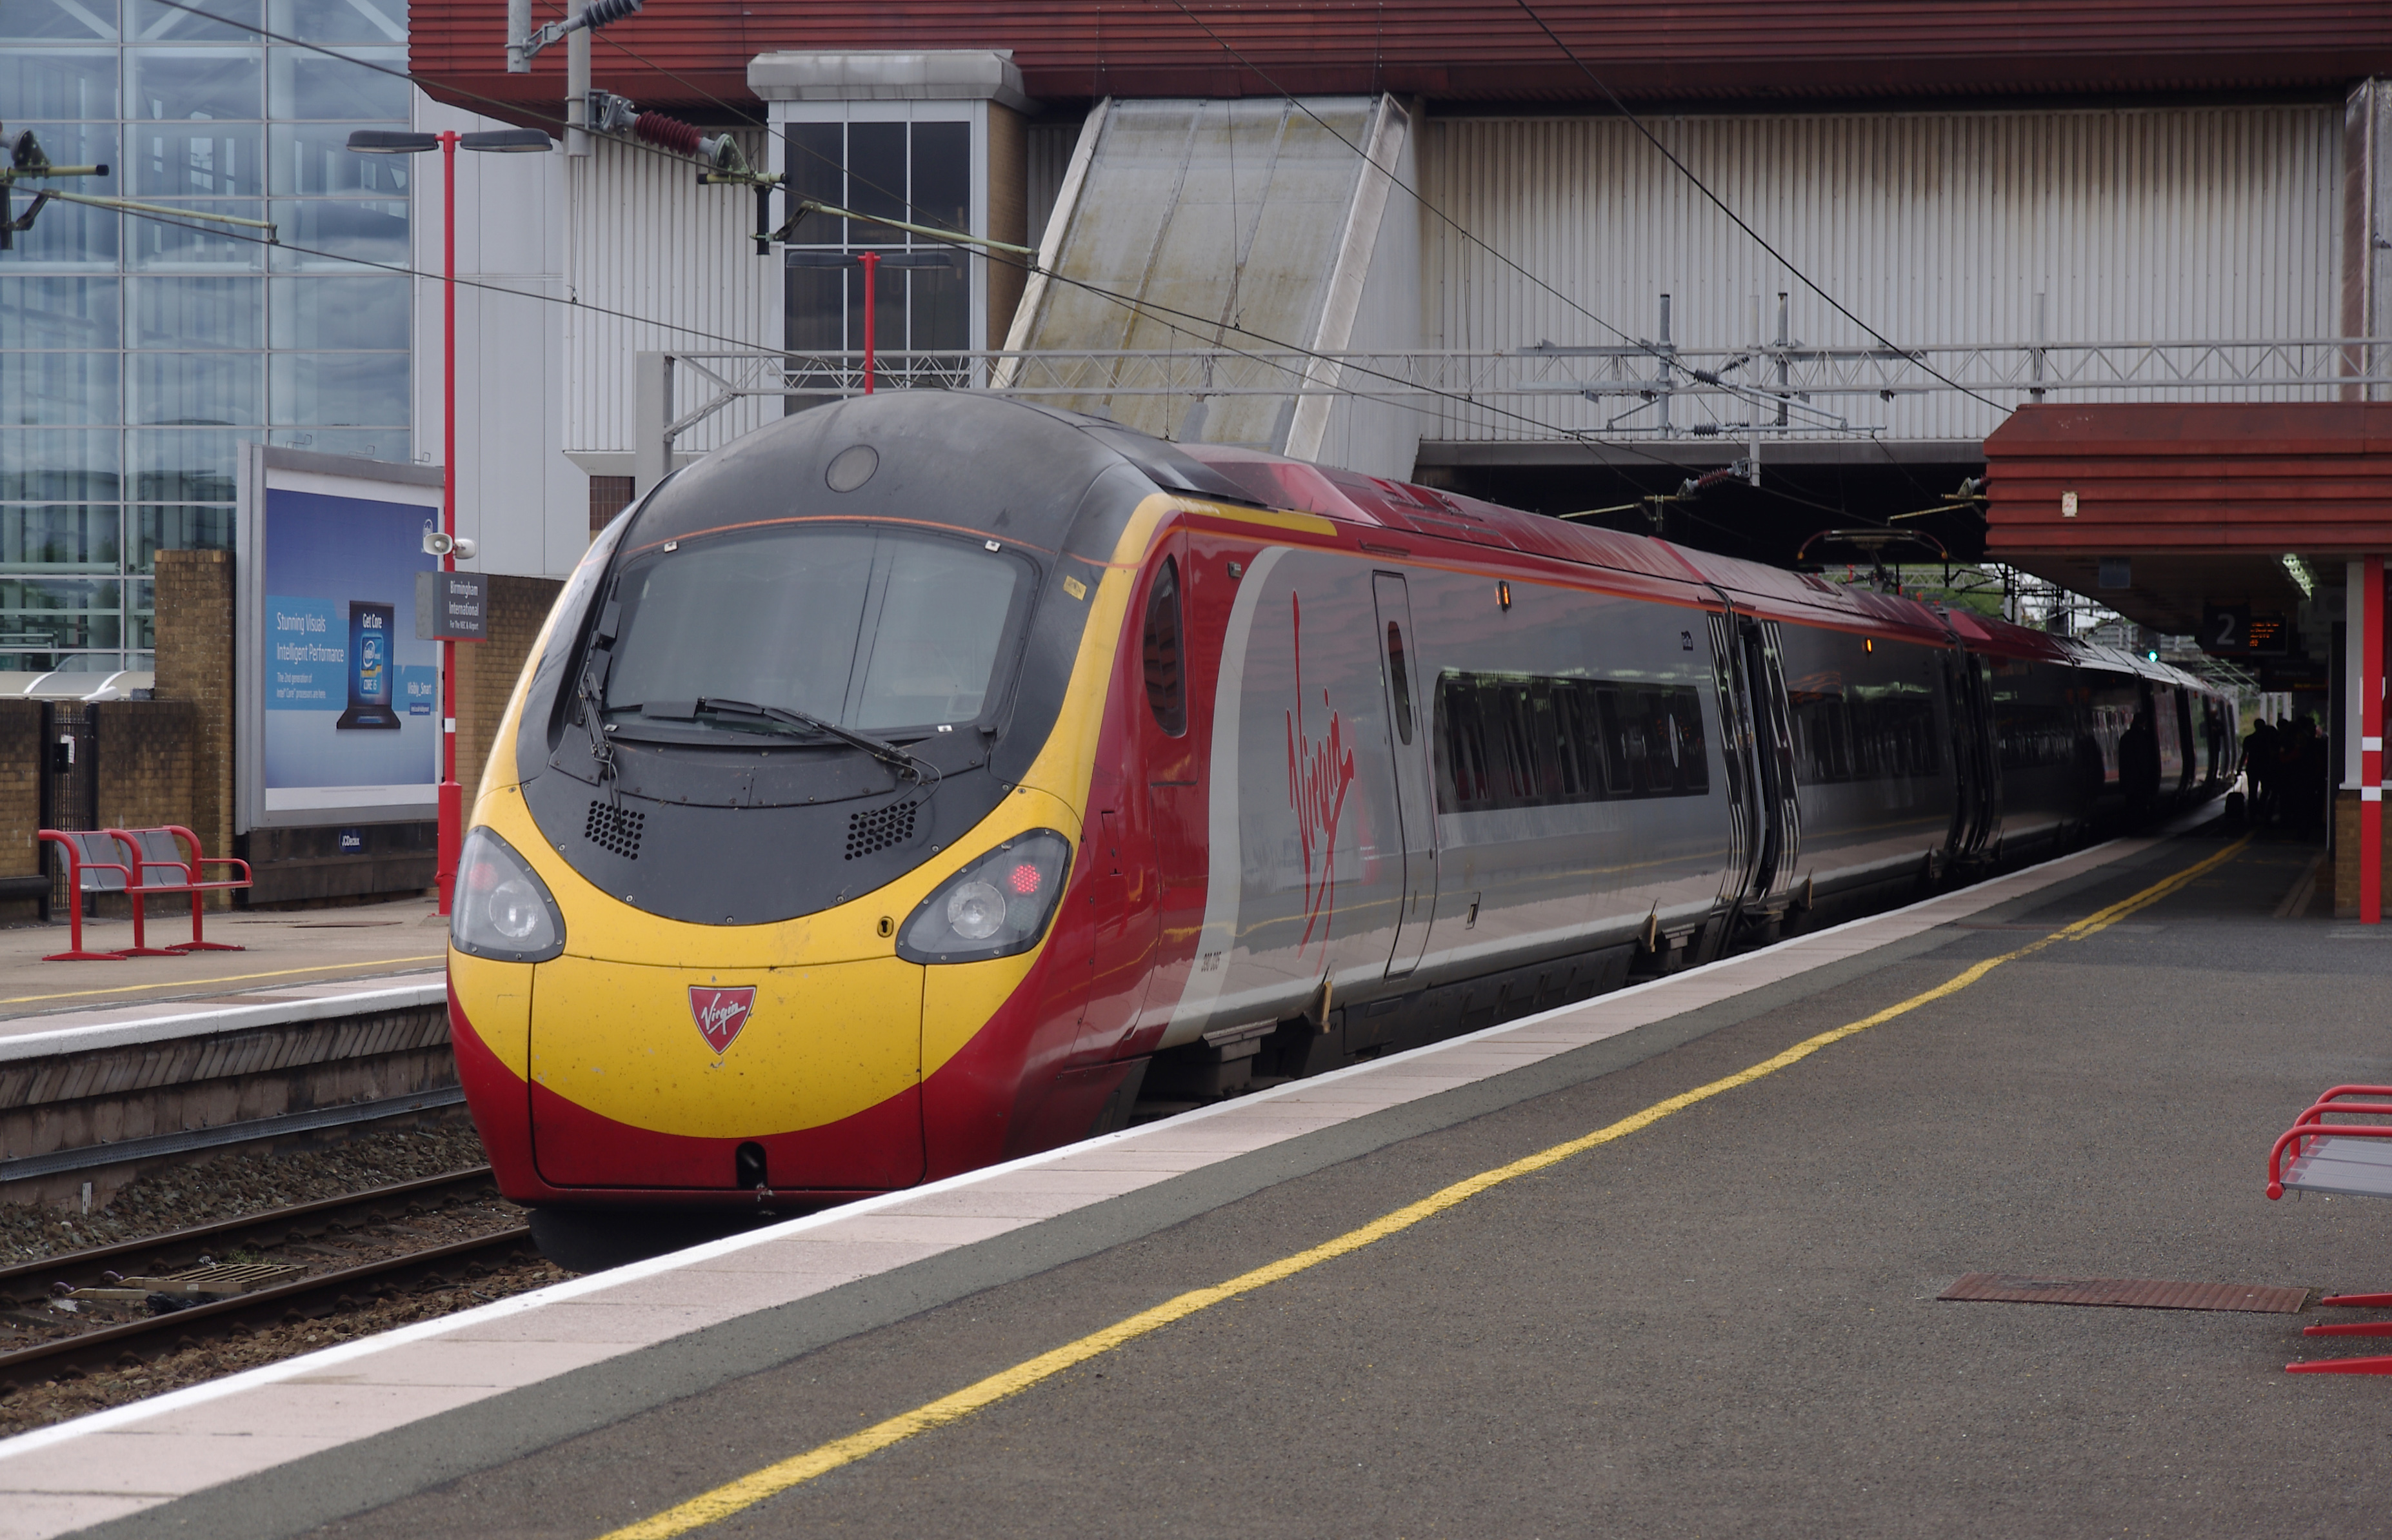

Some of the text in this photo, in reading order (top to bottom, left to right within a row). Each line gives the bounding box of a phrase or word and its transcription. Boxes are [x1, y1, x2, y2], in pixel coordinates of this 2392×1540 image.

[450, 580, 478, 598] Birmingham
[449, 601, 479, 617] International
[277, 612, 326, 635] Stunning Visuals
[363, 613, 383, 629] Get Core
[469, 621, 479, 631] Airport
[2217, 614, 2235, 645] 2
[277, 642, 344, 665] Intelligent Performance
[363, 679, 372, 690] CORE
[1287, 588, 1354, 982] Virgin
[701, 992, 746, 1035] Virgin
